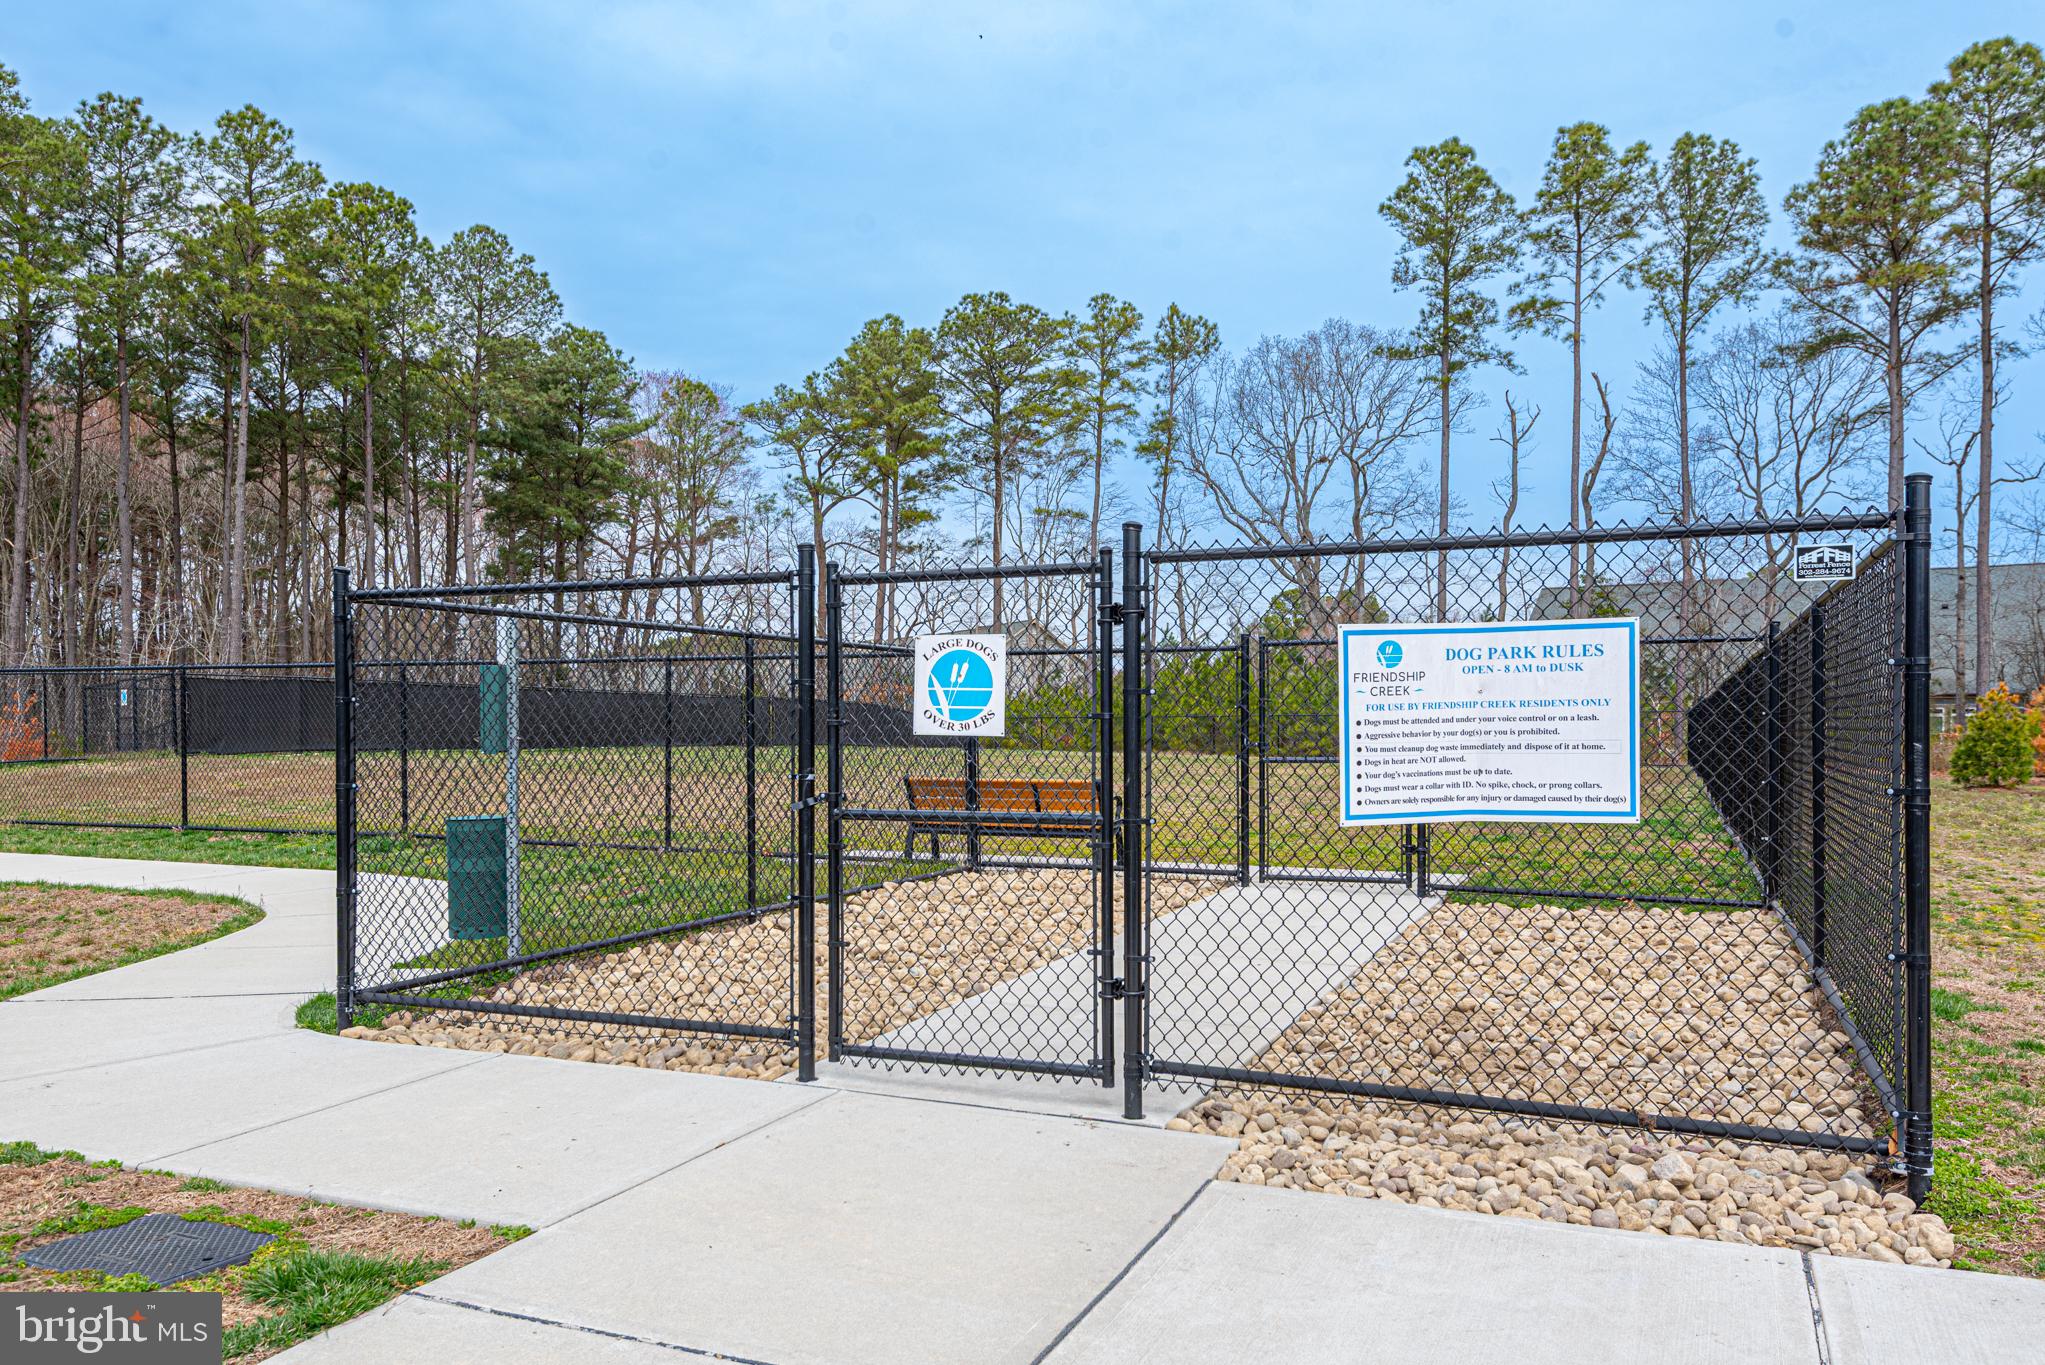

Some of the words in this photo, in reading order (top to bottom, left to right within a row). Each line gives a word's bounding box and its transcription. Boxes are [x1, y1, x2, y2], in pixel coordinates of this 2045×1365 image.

[923, 638, 962, 661] LARGE
[967, 639, 999, 662] DOGS
[1445, 647, 1482, 661] DOG
[1488, 645, 1537, 660] PARK
[1542, 643, 1604, 658] RULES
[1462, 665, 1494, 674] OPEN
[1504, 664, 1510, 673] 8
[1512, 664, 1532, 673] AM
[1536, 663, 1546, 672] to
[1550, 662, 1584, 672] DUSK
[1353, 671, 1426, 683] FRIENDSHIP
[1369, 686, 1410, 697] CREEK
[1366, 704, 1385, 712] FOR
[1388, 703, 1405, 711] USE
[1422, 701, 1479, 710] FRIENDSHIP
[1520, 699, 1579, 708] RESIDENTS
[1581, 698, 1611, 707] ONLY
[923, 709, 955, 731] OVER
[958, 722, 970, 731] 30
[973, 709, 996, 729] LBS
[1364, 719, 1381, 727] Dogs
[1364, 732, 1400, 740] Aggressive
[1433, 730, 1441, 738] by
[1443, 730, 1458, 738] your
[1460, 728, 1482, 737] dog(s)
[1494, 729, 1508, 737] you
[1518, 728, 1560, 737] prohibited.
[1398, 745, 1424, 753] cleanup
[1426, 745, 1438, 753] dog
[1460, 743, 1504, 751] immediately
[1524, 743, 1552, 751] dispose
[1364, 758, 1381, 766] Dogs
[1364, 785, 1381, 793] Dogs
[1489, 781, 1510, 790] spike,
[1512, 781, 1537, 789] chock,
[1574, 781, 1602, 789] collars.
[1402, 797, 1419, 805] solely
[1420, 795, 1455, 804] responsible
[1481, 795, 1501, 803] injury
[1513, 794, 1546, 803] damaged
[1574, 795, 1583, 803] by
[1604, 795, 1627, 804] dog(s)
